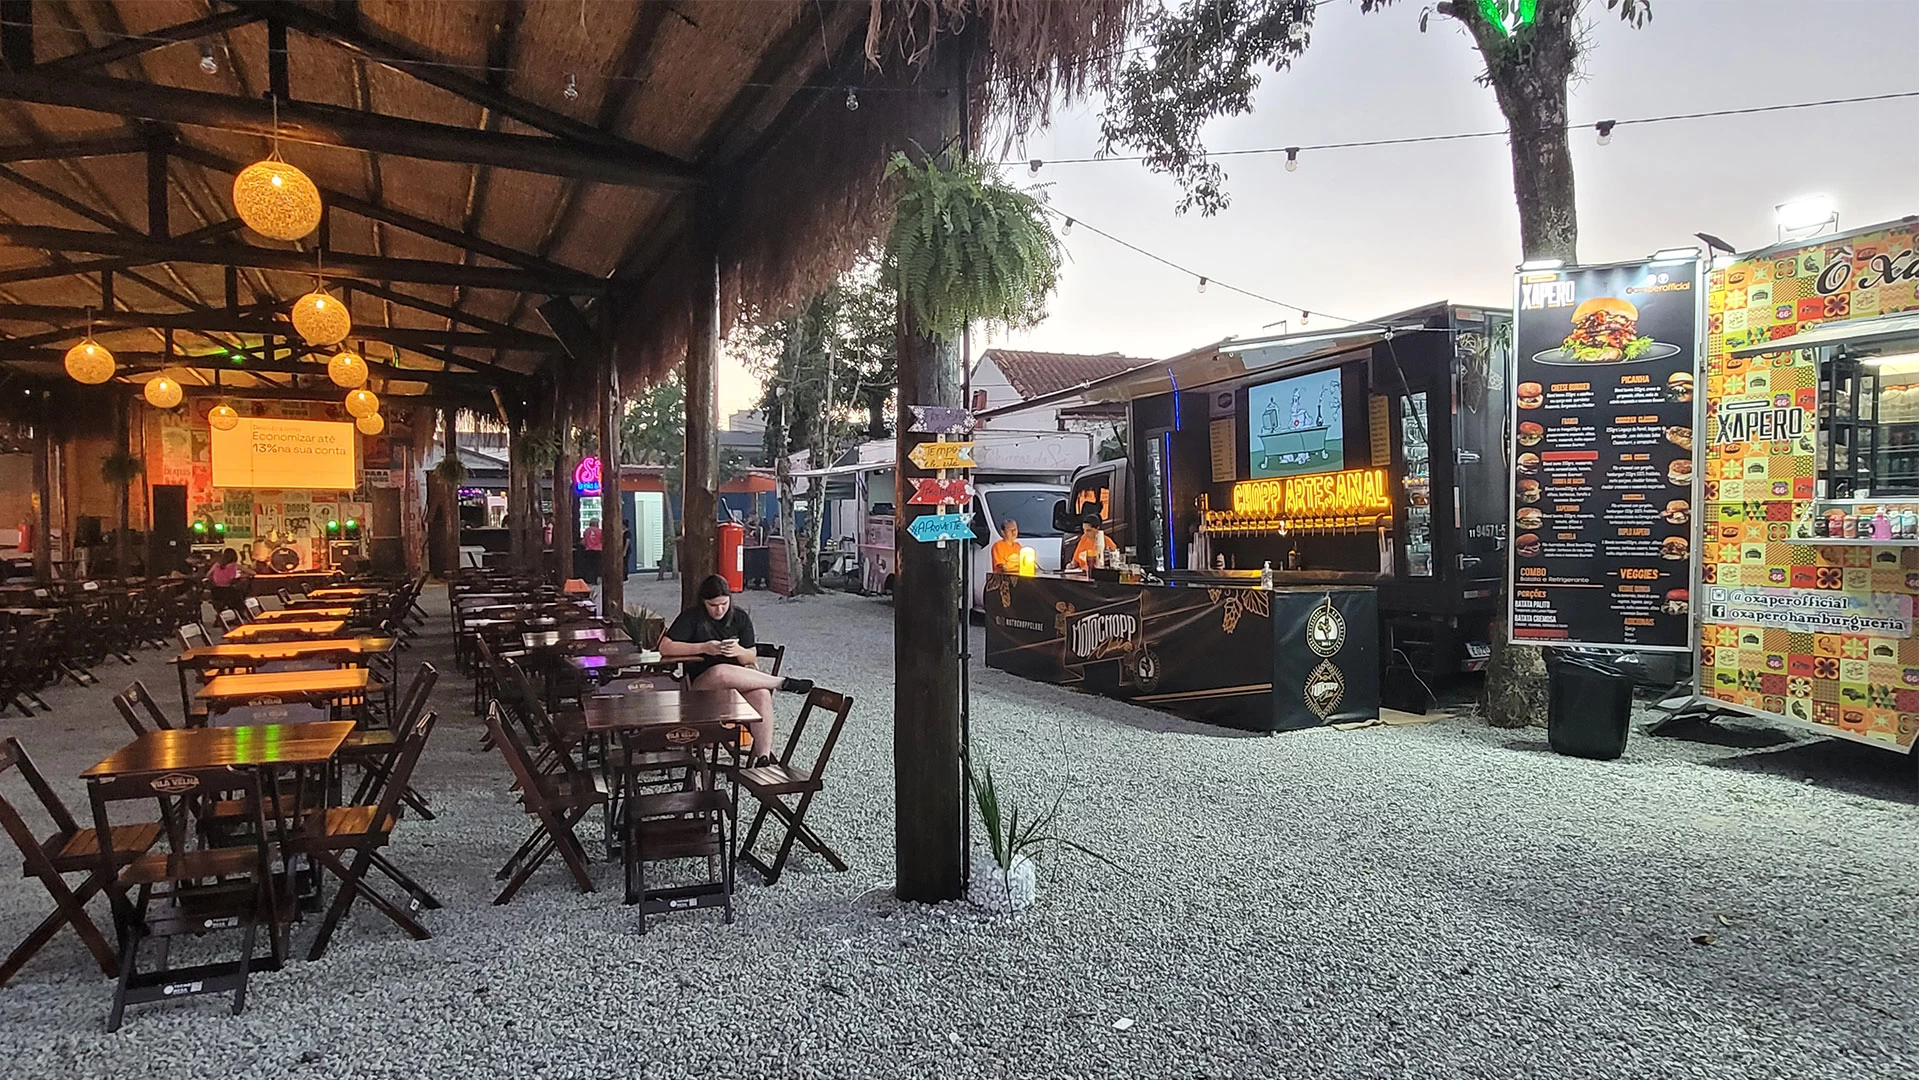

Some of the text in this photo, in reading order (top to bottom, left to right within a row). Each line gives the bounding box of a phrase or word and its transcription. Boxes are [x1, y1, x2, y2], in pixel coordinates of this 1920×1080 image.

[1816, 247, 1853, 295] Ô
[1520, 280, 1575, 310] XAPERO
[1621, 375, 1650, 384] PICANHA
[1716, 408, 1803, 444] XAPERO
[252, 431, 336, 444] Economizar até
[294, 446, 313, 454] sua
[315, 446, 346, 455] conta
[1234, 469, 1390, 516] CHOPP ARTESANAL
[1520, 567, 1547, 577] COMBO
[1548, 576, 1590, 584] Refrigerante
[1620, 568, 1659, 580] VEGGIES
[1730, 590, 1849, 609] @oxaperofficial
[1731, 609, 1905, 631] oxaperohamburgueria
[1071, 613, 1137, 658] MOTOCHOPP
